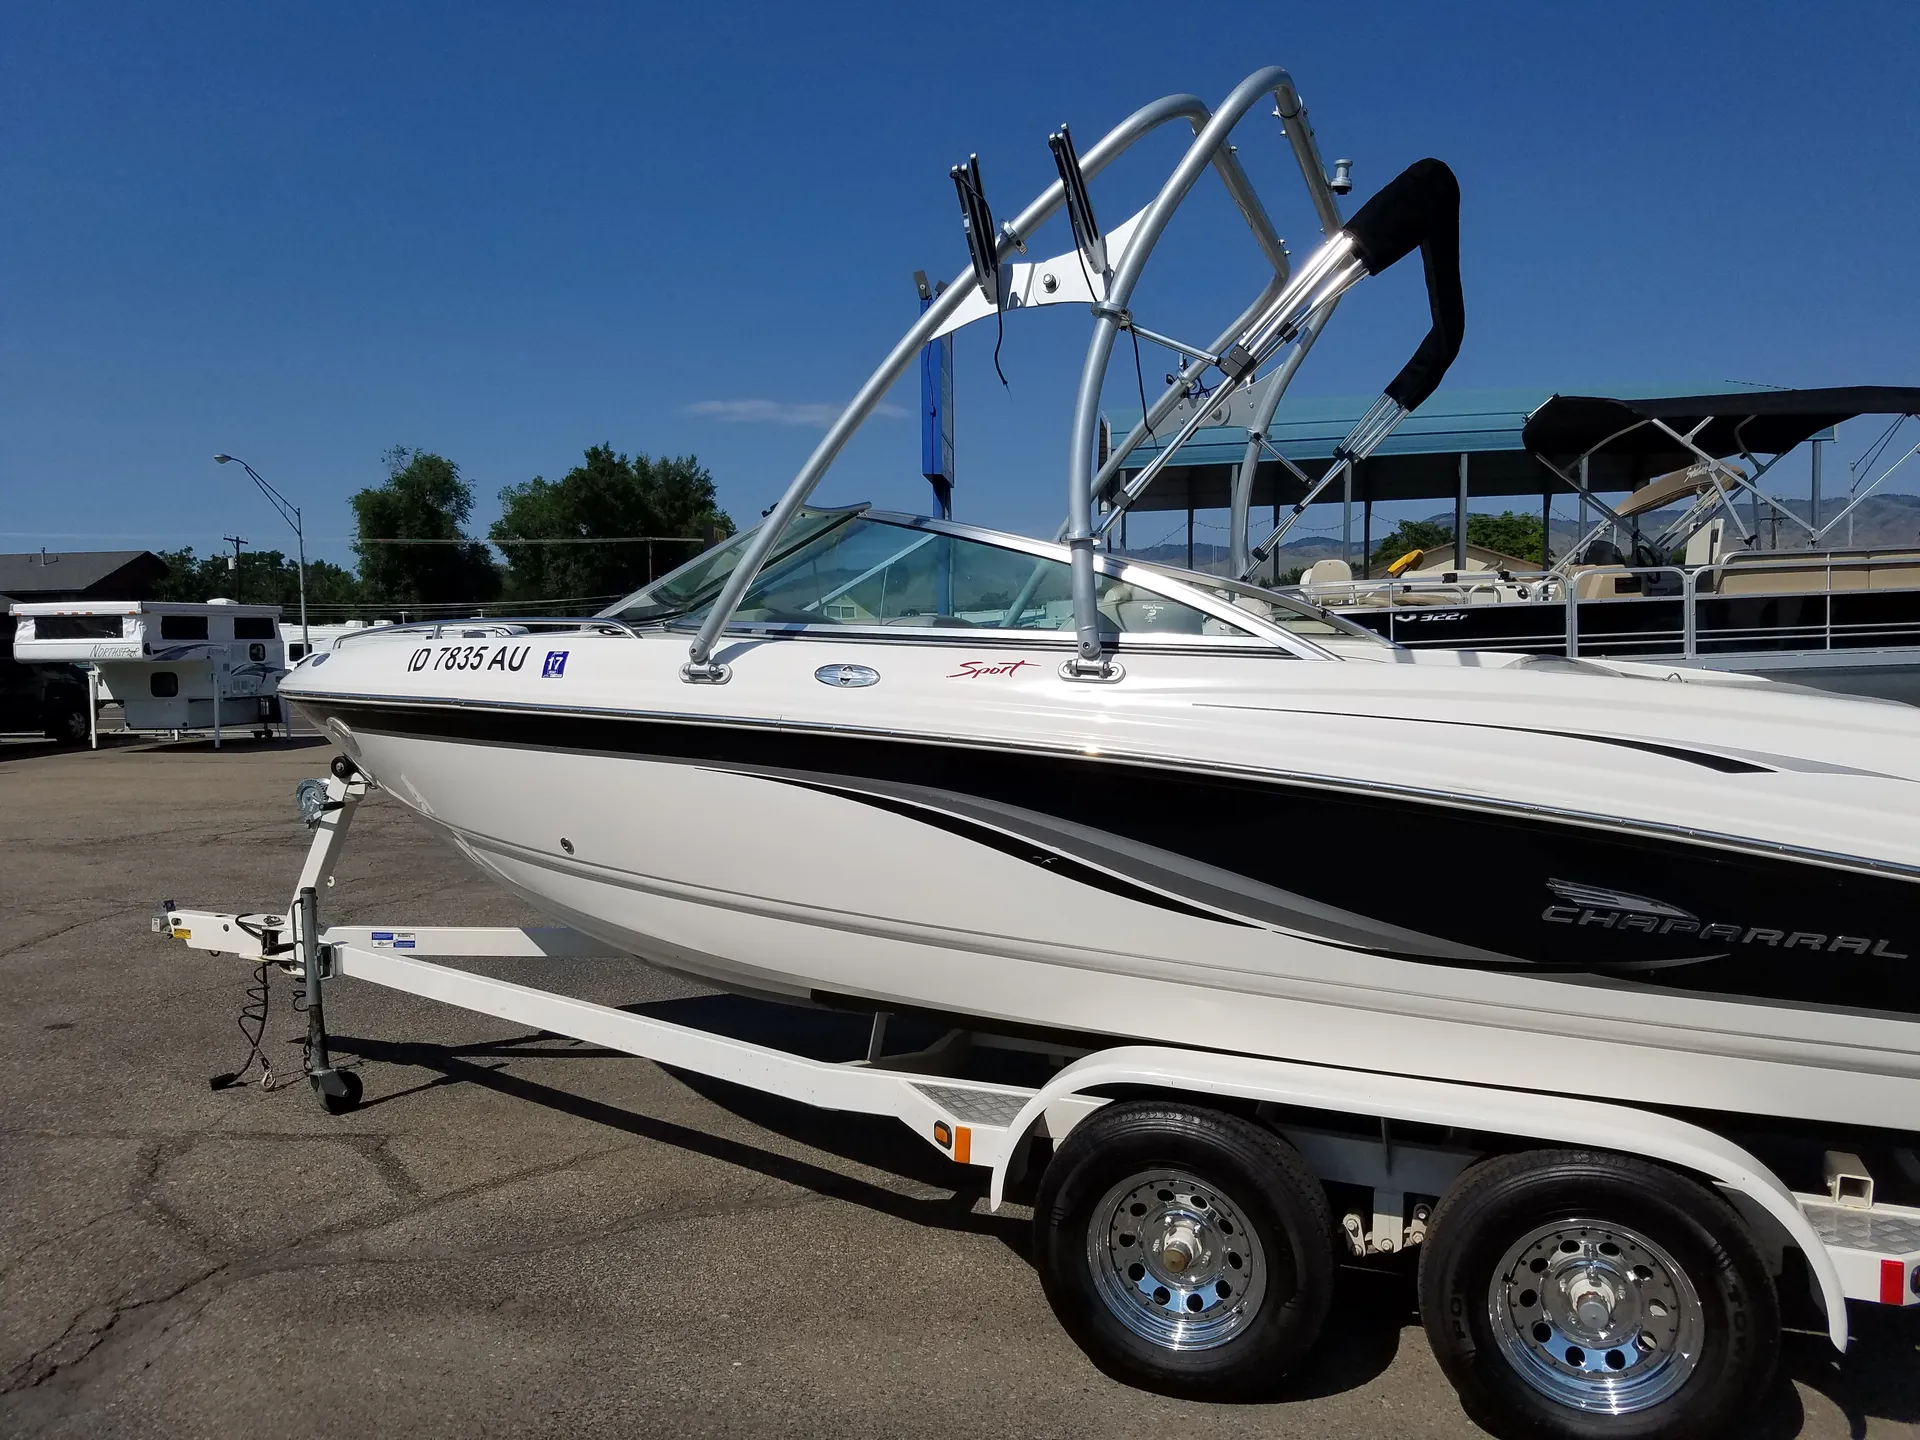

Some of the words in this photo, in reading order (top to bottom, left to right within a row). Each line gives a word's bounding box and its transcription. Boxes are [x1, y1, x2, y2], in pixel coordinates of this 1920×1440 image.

[407, 648, 432, 672] ID
[434, 646, 489, 671] 7835
[487, 645, 531, 672] AU
[548, 656, 563, 672] 17
[946, 660, 1042, 678] Sport
[1541, 904, 1909, 960] CHAPARRAL
